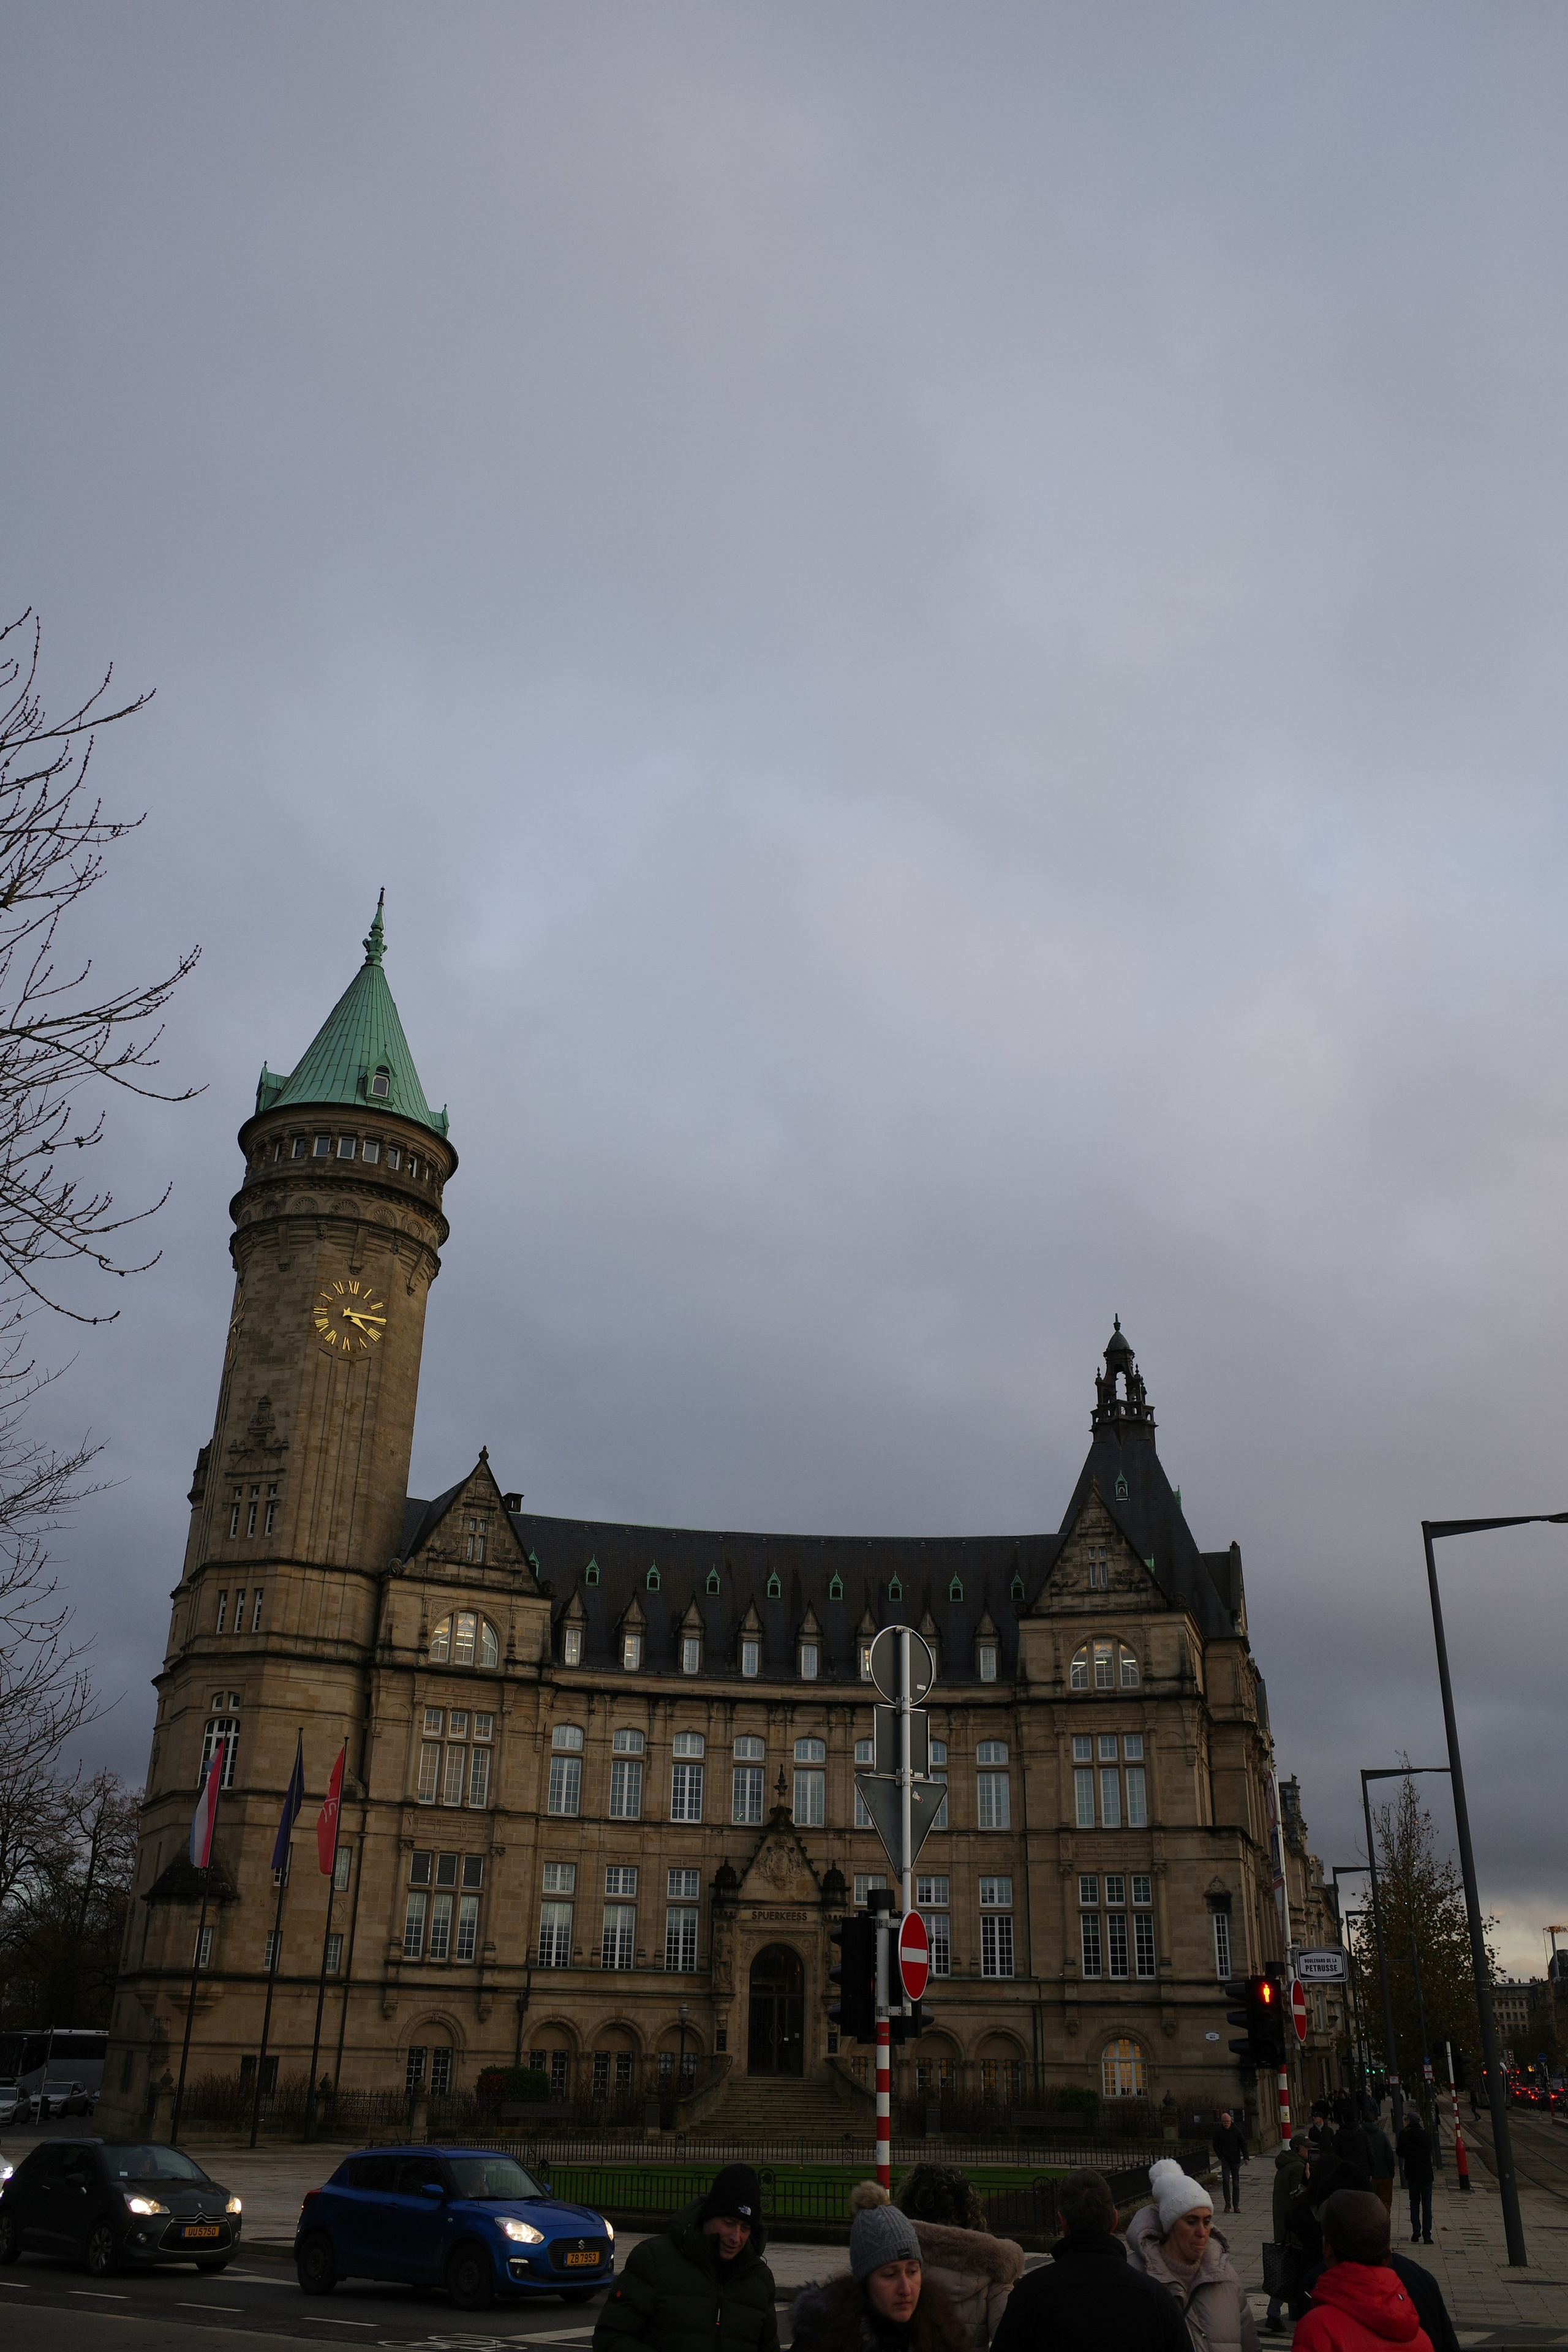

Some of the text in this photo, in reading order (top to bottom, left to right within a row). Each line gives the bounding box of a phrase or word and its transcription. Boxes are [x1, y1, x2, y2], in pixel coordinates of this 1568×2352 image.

[752, 1910, 807, 1921] SPUERKEESS
[571, 2253, 597, 2263] ZB 7953
